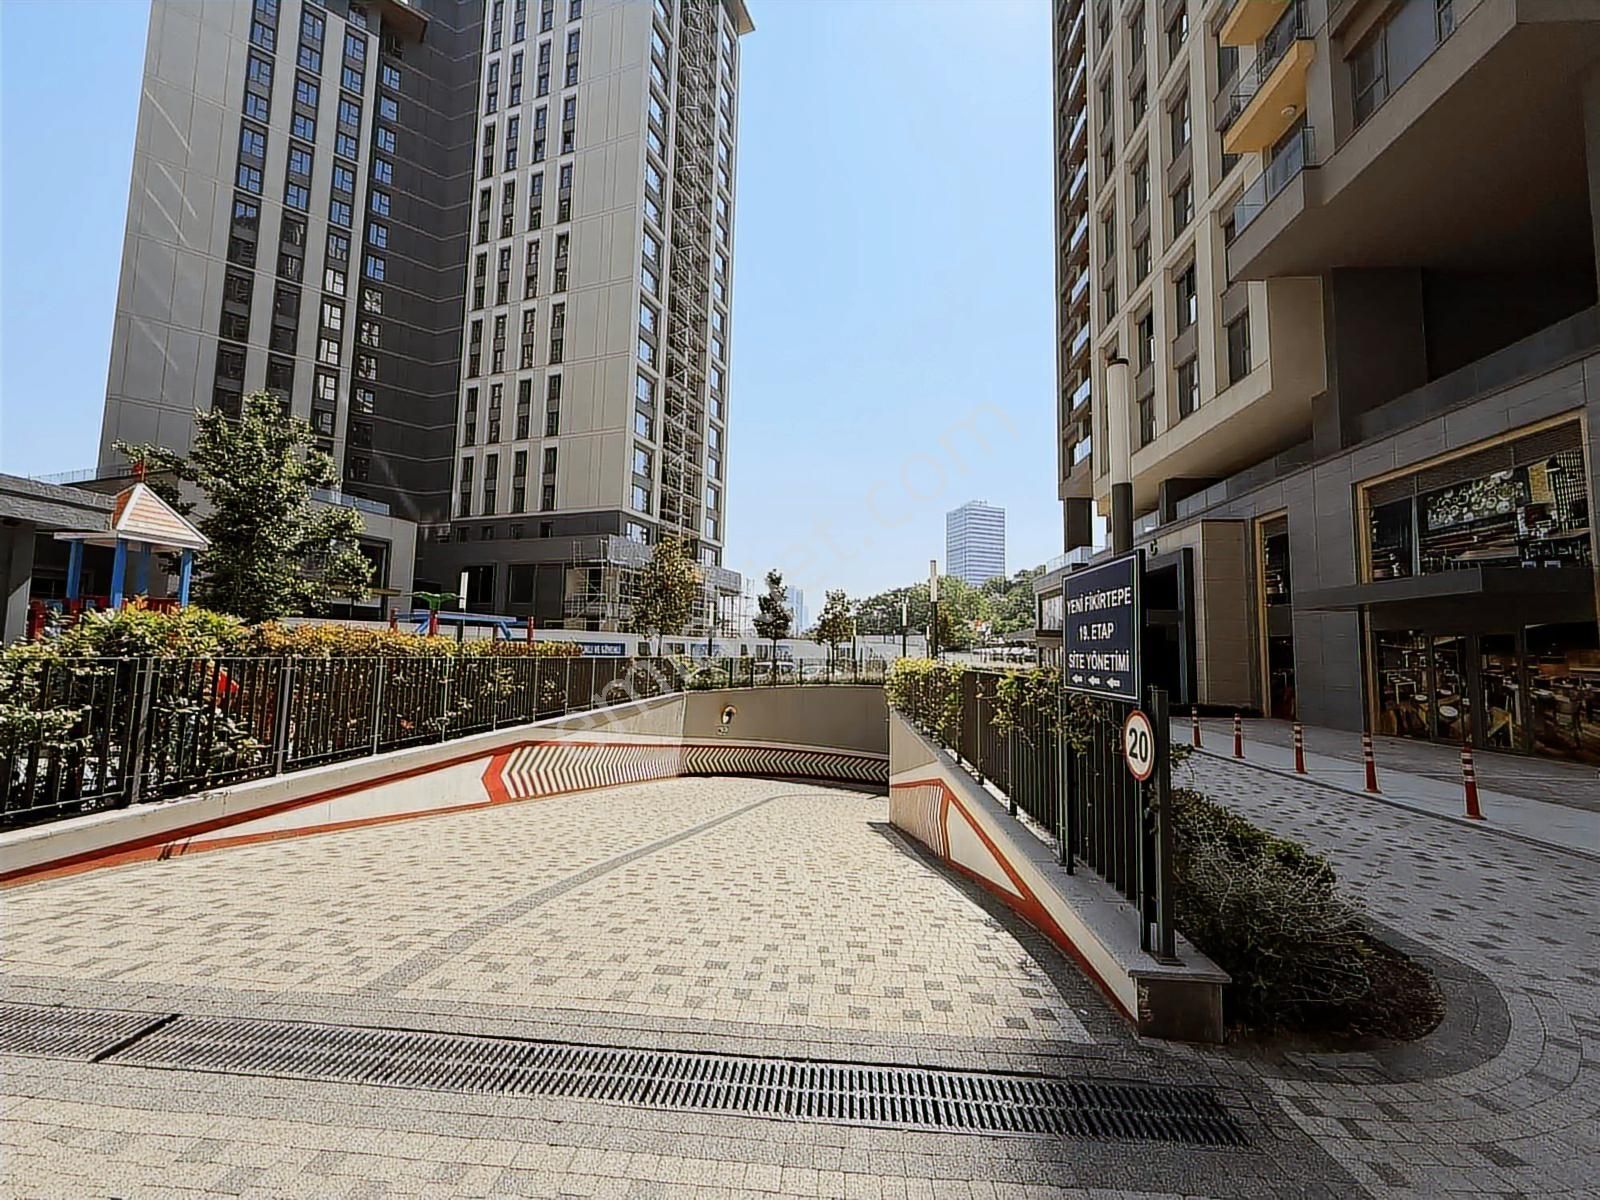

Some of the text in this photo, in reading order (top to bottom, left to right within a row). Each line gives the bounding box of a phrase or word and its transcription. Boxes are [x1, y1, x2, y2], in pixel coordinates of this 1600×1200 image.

[1067, 586, 1132, 615] YENİ FİKİRTEPE
[1091, 622, 1114, 640] ETAP
[1068, 650, 1130, 672] SİTE YÖNETİMİ
[1129, 727, 1147, 763] 20
